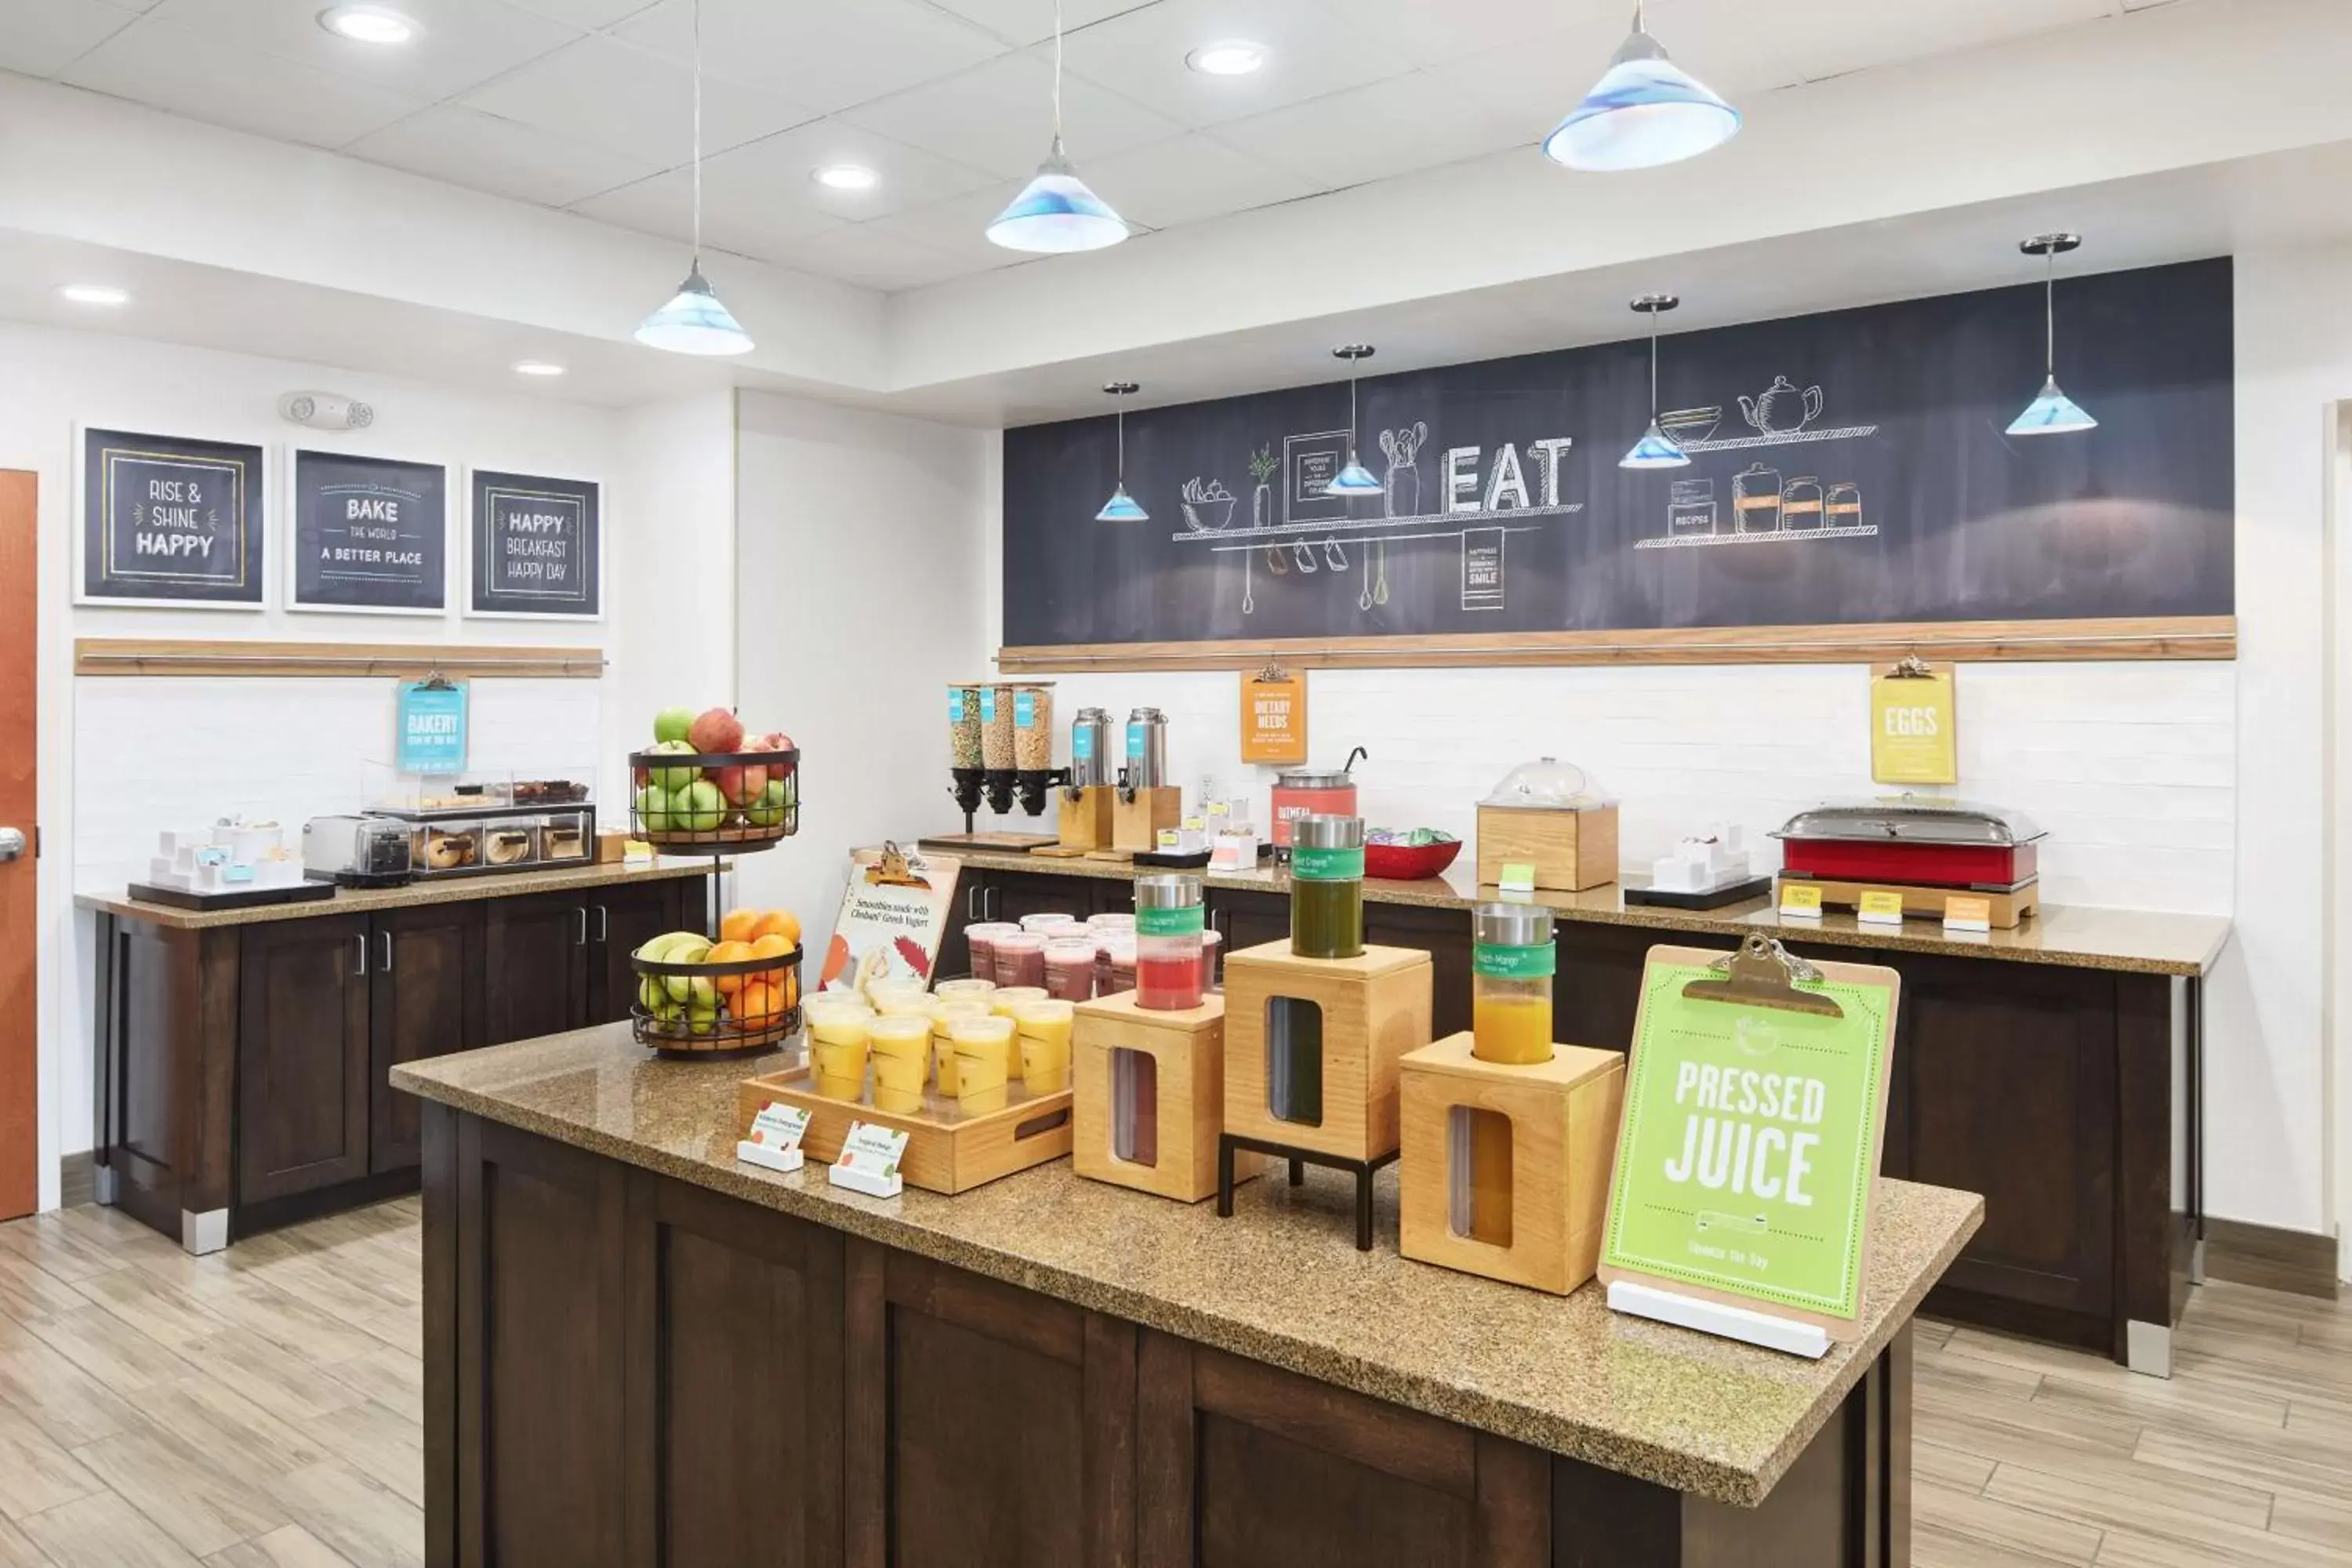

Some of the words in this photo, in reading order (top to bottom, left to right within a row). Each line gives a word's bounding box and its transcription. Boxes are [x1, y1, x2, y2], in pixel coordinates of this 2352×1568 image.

[1441, 437, 1572, 514] EAT
[150, 479, 183, 503] RISE
[188, 482, 201, 503] &
[152, 506, 198, 529] SHINE
[347, 498, 398, 522] BAKE
[368, 527, 397, 540] WORLD
[509, 512, 564, 535] HAPPY
[136, 532, 214, 558] HAPPY
[321, 547, 330, 560] A
[335, 548, 381, 562] BETTER
[385, 551, 423, 565] PLACE
[506, 537, 566, 558] BREAKFAST
[506, 561, 543, 580] HAPPY
[546, 562, 567, 581] DAY
[1468, 572, 1497, 585] SMILE
[408, 713, 458, 734] BAKERY
[1884, 706, 1938, 735] EGGS
[1675, 1061, 1826, 1124] PRESSED
[1664, 1114, 1820, 1206] JUICE
